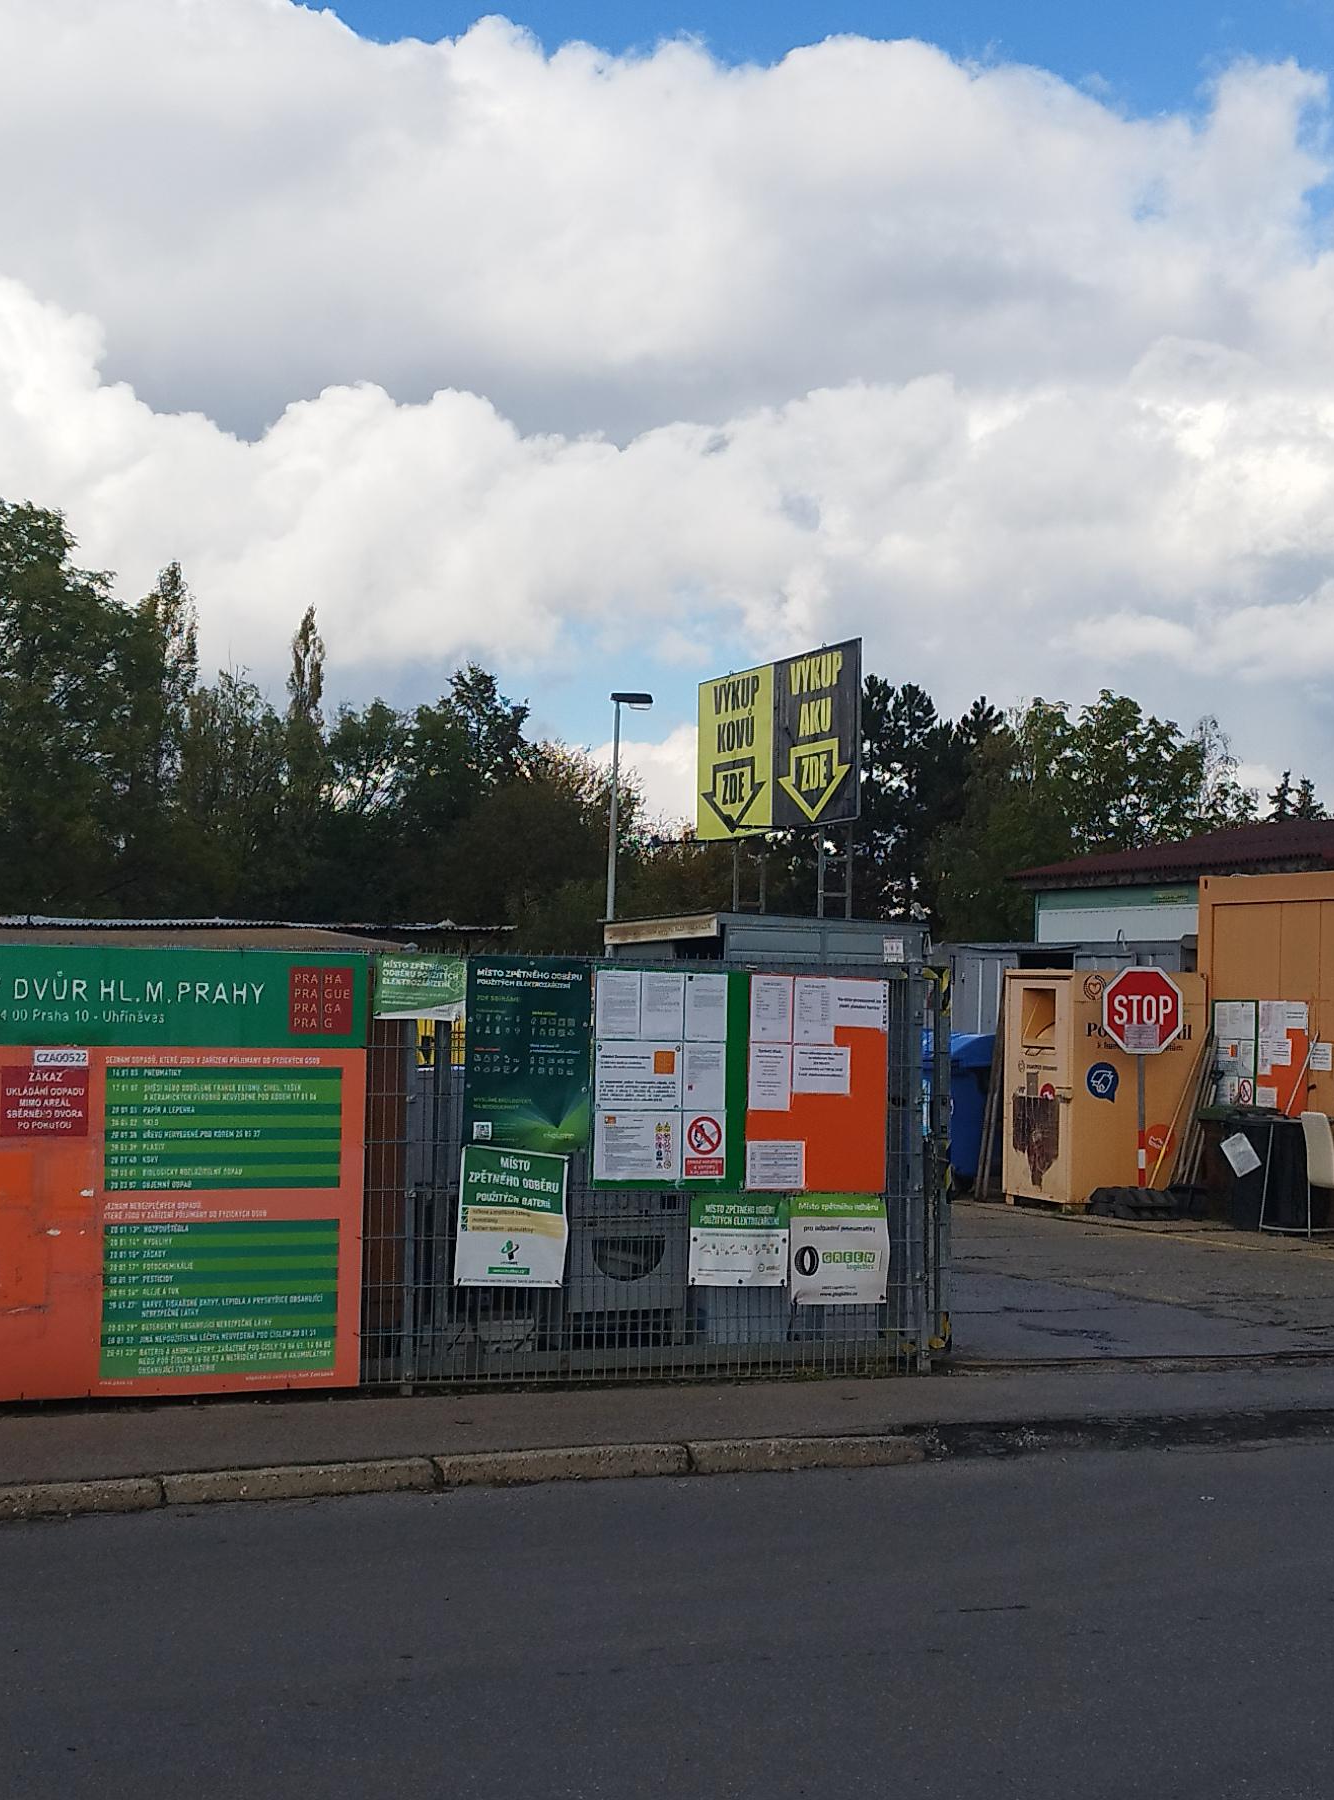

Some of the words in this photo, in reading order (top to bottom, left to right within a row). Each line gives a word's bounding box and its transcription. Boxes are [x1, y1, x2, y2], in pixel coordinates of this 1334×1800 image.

[790, 651, 843, 696] VÝKUP
[713, 673, 760, 715] VÝKUP
[799, 697, 832, 738] AKU
[717, 709, 755, 754] KOVŮ
[801, 753, 828, 792] ZDE
[722, 772, 745, 805] ZDE
[383, 959, 409, 968] MÍSTO
[410, 961, 449, 971] ZPĚTNÉHO
[295, 974, 318, 984] PRA
[325, 975, 342, 984] HA
[382, 968, 417, 978] ODBĚRU
[476, 967, 504, 977] MÍSTO
[505, 968, 550, 980] ZPĚTNÉHO
[551, 970, 583, 981] ODBĚRU
[13, 971, 88, 1002] DVŮR
[476, 978, 515, 988] POUŽITÝCH
[295, 988, 318, 999] PRA
[324, 989, 350, 1000] GUE
[294, 1003, 317, 1013] PRA
[324, 1003, 341, 1014] GA
[1113, 994, 1172, 1025] STOP
[12, 1009, 28, 1021] 00
[33, 1008, 69, 1022] Praha
[75, 1010, 89, 1022] 10
[102, 1010, 165, 1023] Uhříněvas
[294, 1018, 317, 1028] PRA
[324, 1018, 332, 1028] G
[28, 1069, 65, 1082] ZÁKAZ
[6, 1086, 48, 1096] UKLÁDÁNÍ
[51, 1087, 84, 1096] ODPADU
[19, 1098, 41, 1107] MIMO
[43, 1097, 71, 1107] AREÁL
[54, 1109, 83, 1118] DVORA
[18, 1121, 29, 1130] PO
[32, 1120, 72, 1130] POKUTOU
[500, 1156, 531, 1171] MÍSTO
[468, 1170, 520, 1187] ZPĚTNÉHO
[522, 1178, 559, 1194] ODBĚRU
[476, 1191, 519, 1205] POUŽITÝCH
[705, 1203, 725, 1213] MÍSTO
[798, 1202, 819, 1210] Místo
[822, 1251, 875, 1264] GREEN
[142, 1275, 174, 1284] PESTICIDY
